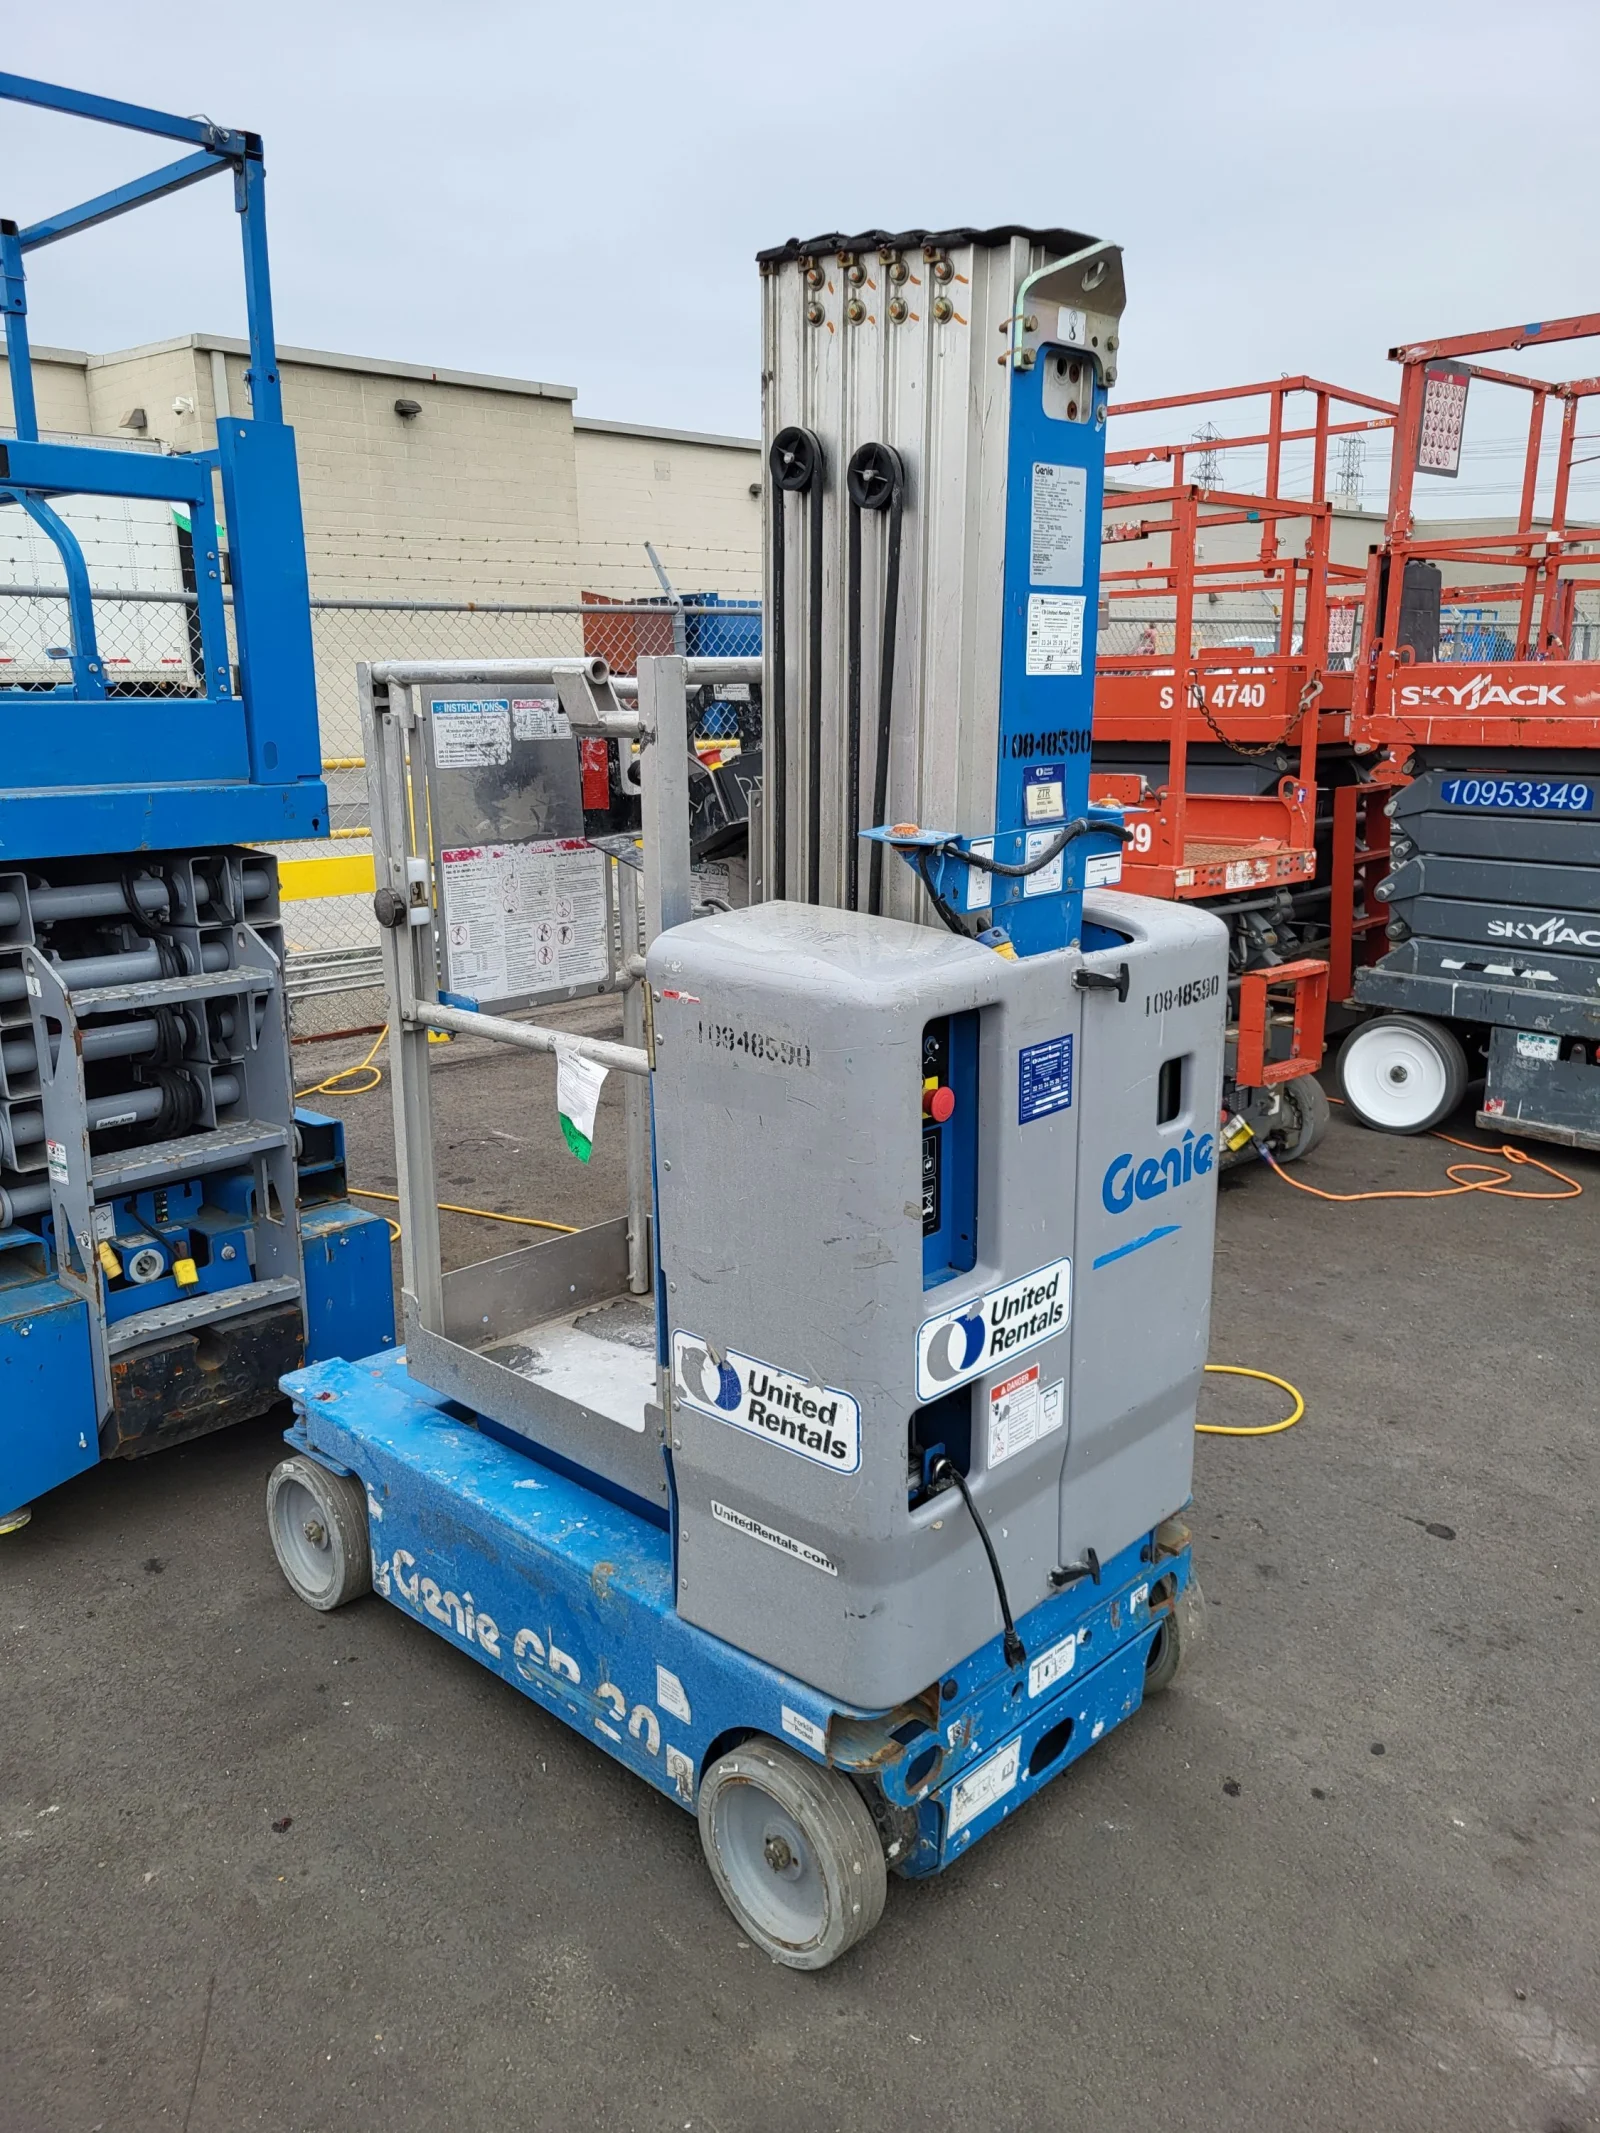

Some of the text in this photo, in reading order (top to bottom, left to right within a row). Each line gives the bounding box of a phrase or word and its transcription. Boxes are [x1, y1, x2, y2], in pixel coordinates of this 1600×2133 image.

[1035, 465, 1053, 476] Genie
[443, 701, 502, 713] INSTRUCTIONS
[1211, 684, 1266, 708] 4740
[1400, 673, 1567, 711] SKYJACK
[1003, 729, 1091, 759] 10848590
[1037, 789, 1050, 799] ZTR
[1449, 779, 1588, 810] 10953349
[1145, 975, 1219, 1017] 10848590
[699, 1020, 811, 1068] 10848590
[100, 1120, 118, 1128] Safety
[1103, 1129, 1213, 1214] Genie
[991, 1272, 1059, 1326] United
[990, 1301, 1063, 1357] Rentals
[749, 1370, 838, 1427] United
[1006, 1373, 1029, 1391] DANGER
[748, 1398, 848, 1459] Rentals
[714, 1503, 835, 1571] UnitedRentals.com
[392, 1549, 500, 1659] Genie
[793, 1716, 814, 1734] Forklift
[794, 1724, 814, 1742] Pocket
